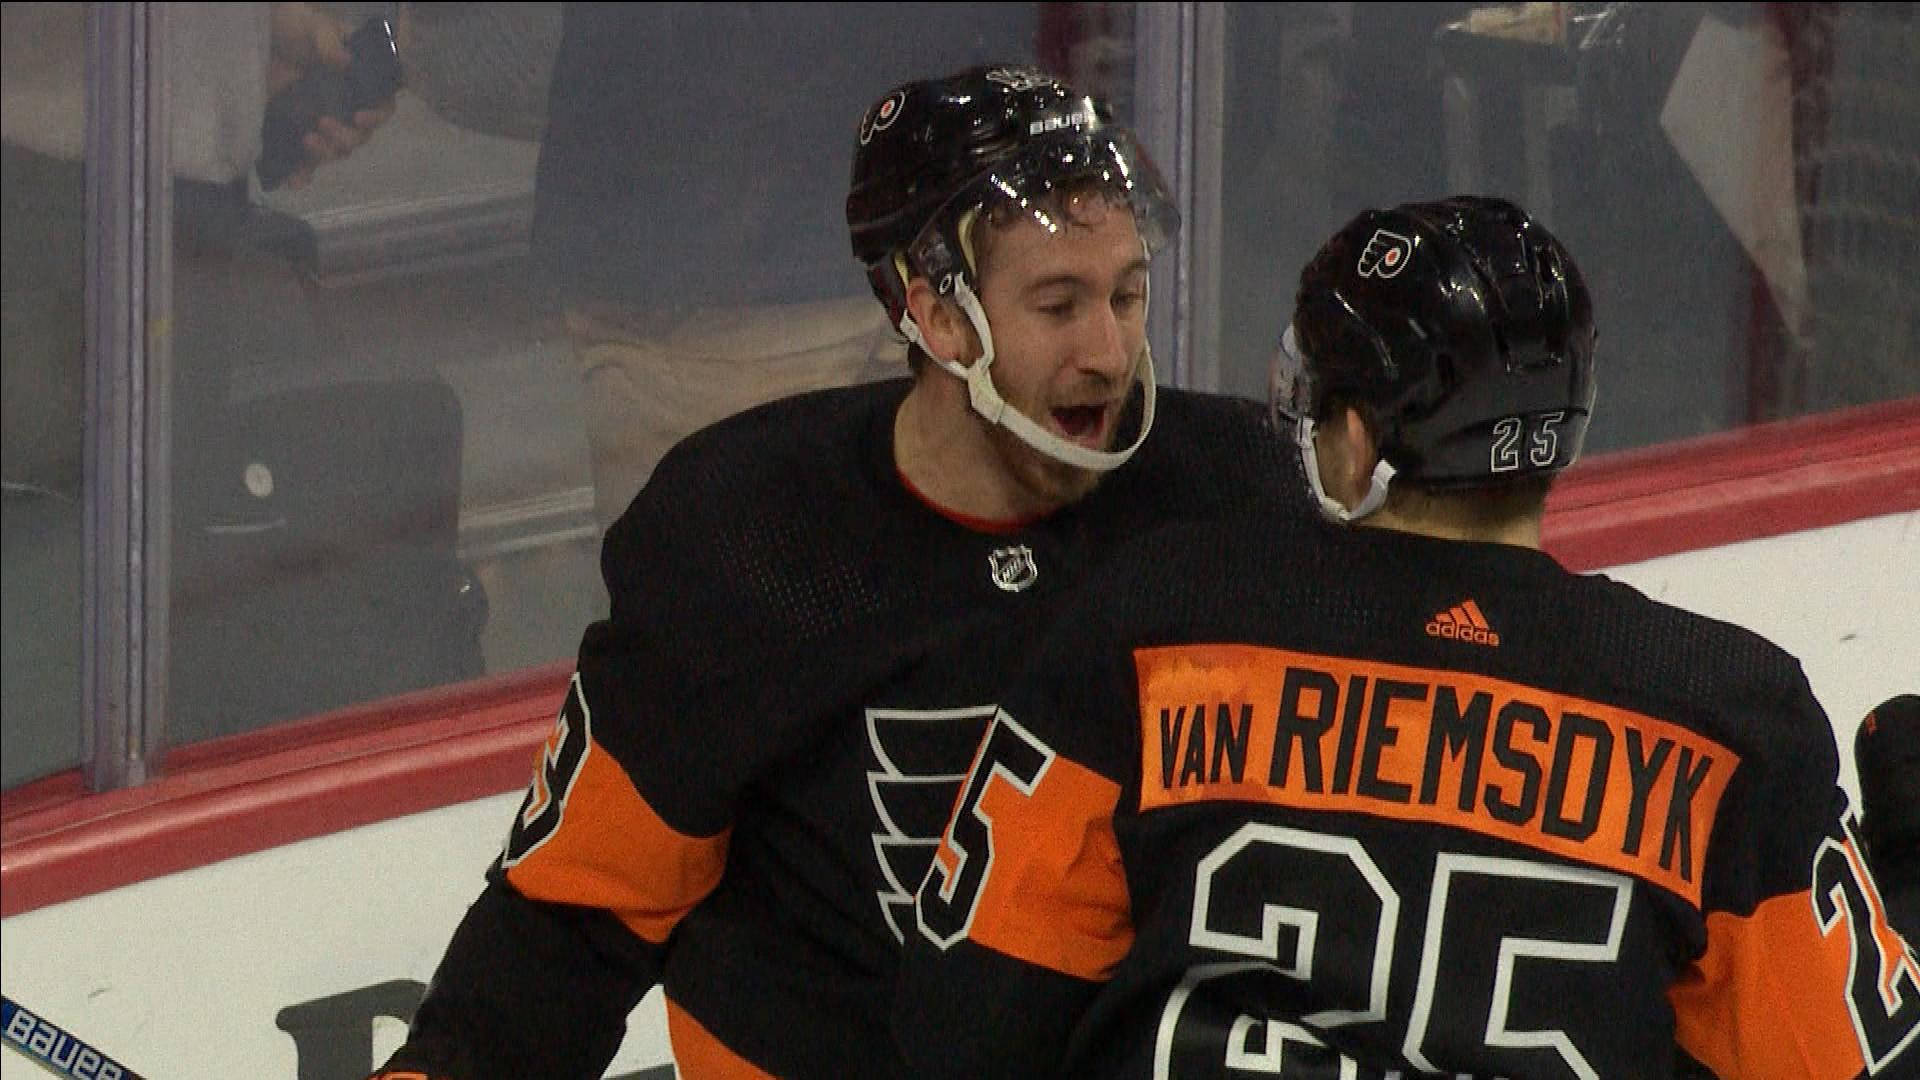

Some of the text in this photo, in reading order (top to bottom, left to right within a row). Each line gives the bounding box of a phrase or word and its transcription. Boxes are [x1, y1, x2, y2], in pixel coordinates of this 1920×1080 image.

[1491, 411, 1565, 473] 25
[1425, 620, 1500, 647] adidas
[1160, 667, 1713, 884] VAN RIEMSDYK
[1153, 821, 1633, 1080] 25
